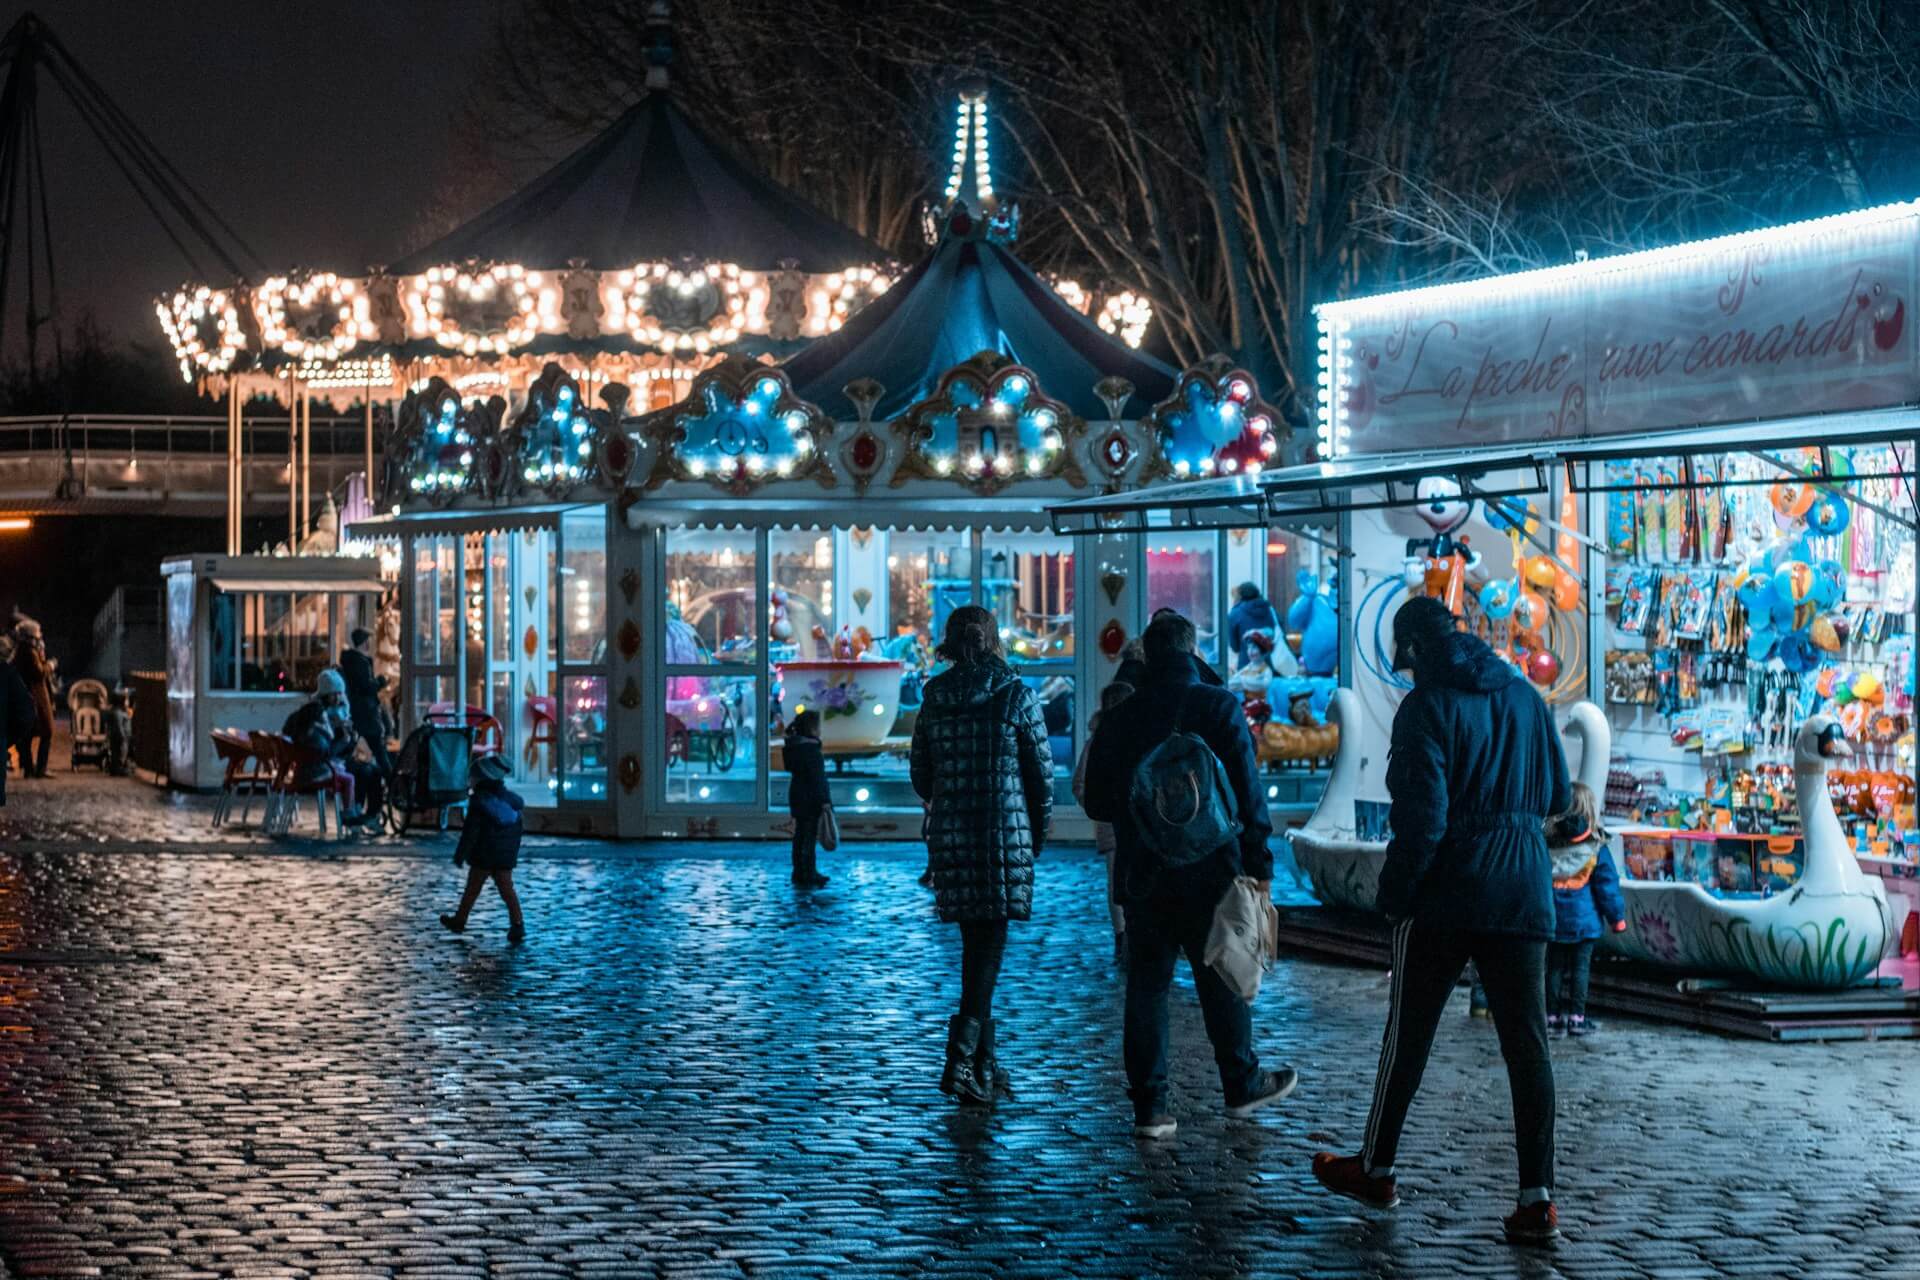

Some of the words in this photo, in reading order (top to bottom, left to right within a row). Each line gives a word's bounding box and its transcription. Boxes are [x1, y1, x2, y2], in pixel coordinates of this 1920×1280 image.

[1379, 320, 1465, 404] La
[1599, 337, 1677, 381] aux
[1683, 268, 1862, 374] canards
